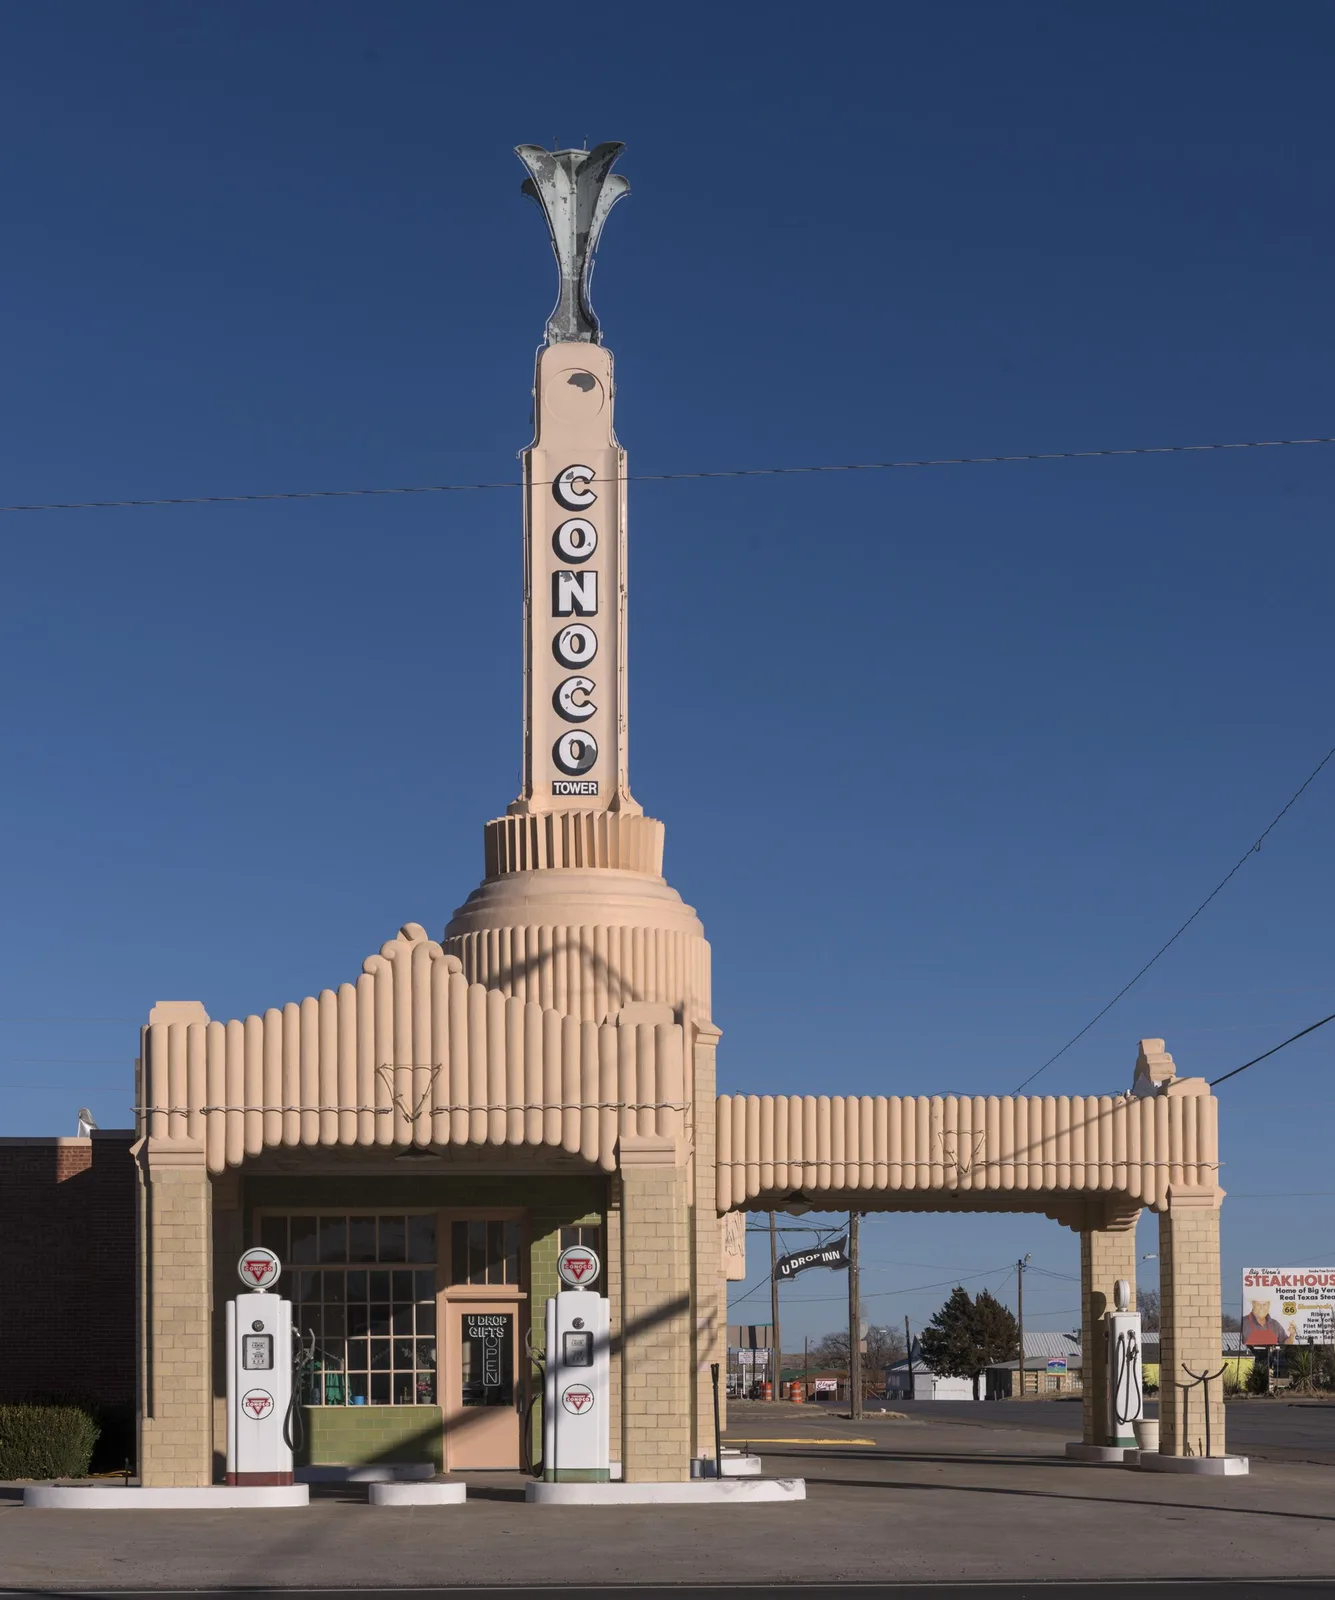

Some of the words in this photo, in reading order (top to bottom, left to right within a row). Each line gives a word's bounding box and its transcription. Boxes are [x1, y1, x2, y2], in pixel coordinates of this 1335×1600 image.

[552, 464, 598, 776] CONOCO
[553, 782, 598, 794] TOWER
[781, 1264, 790, 1275] U
[790, 1253, 821, 1269] DROP
[821, 1250, 840, 1262] INN
[1308, 1287, 1319, 1295] Big
[468, 1316, 475, 1325] U
[477, 1316, 507, 1325] DROP
[469, 1327, 504, 1337] GIFTS
[485, 1336, 498, 1384] OPEN
